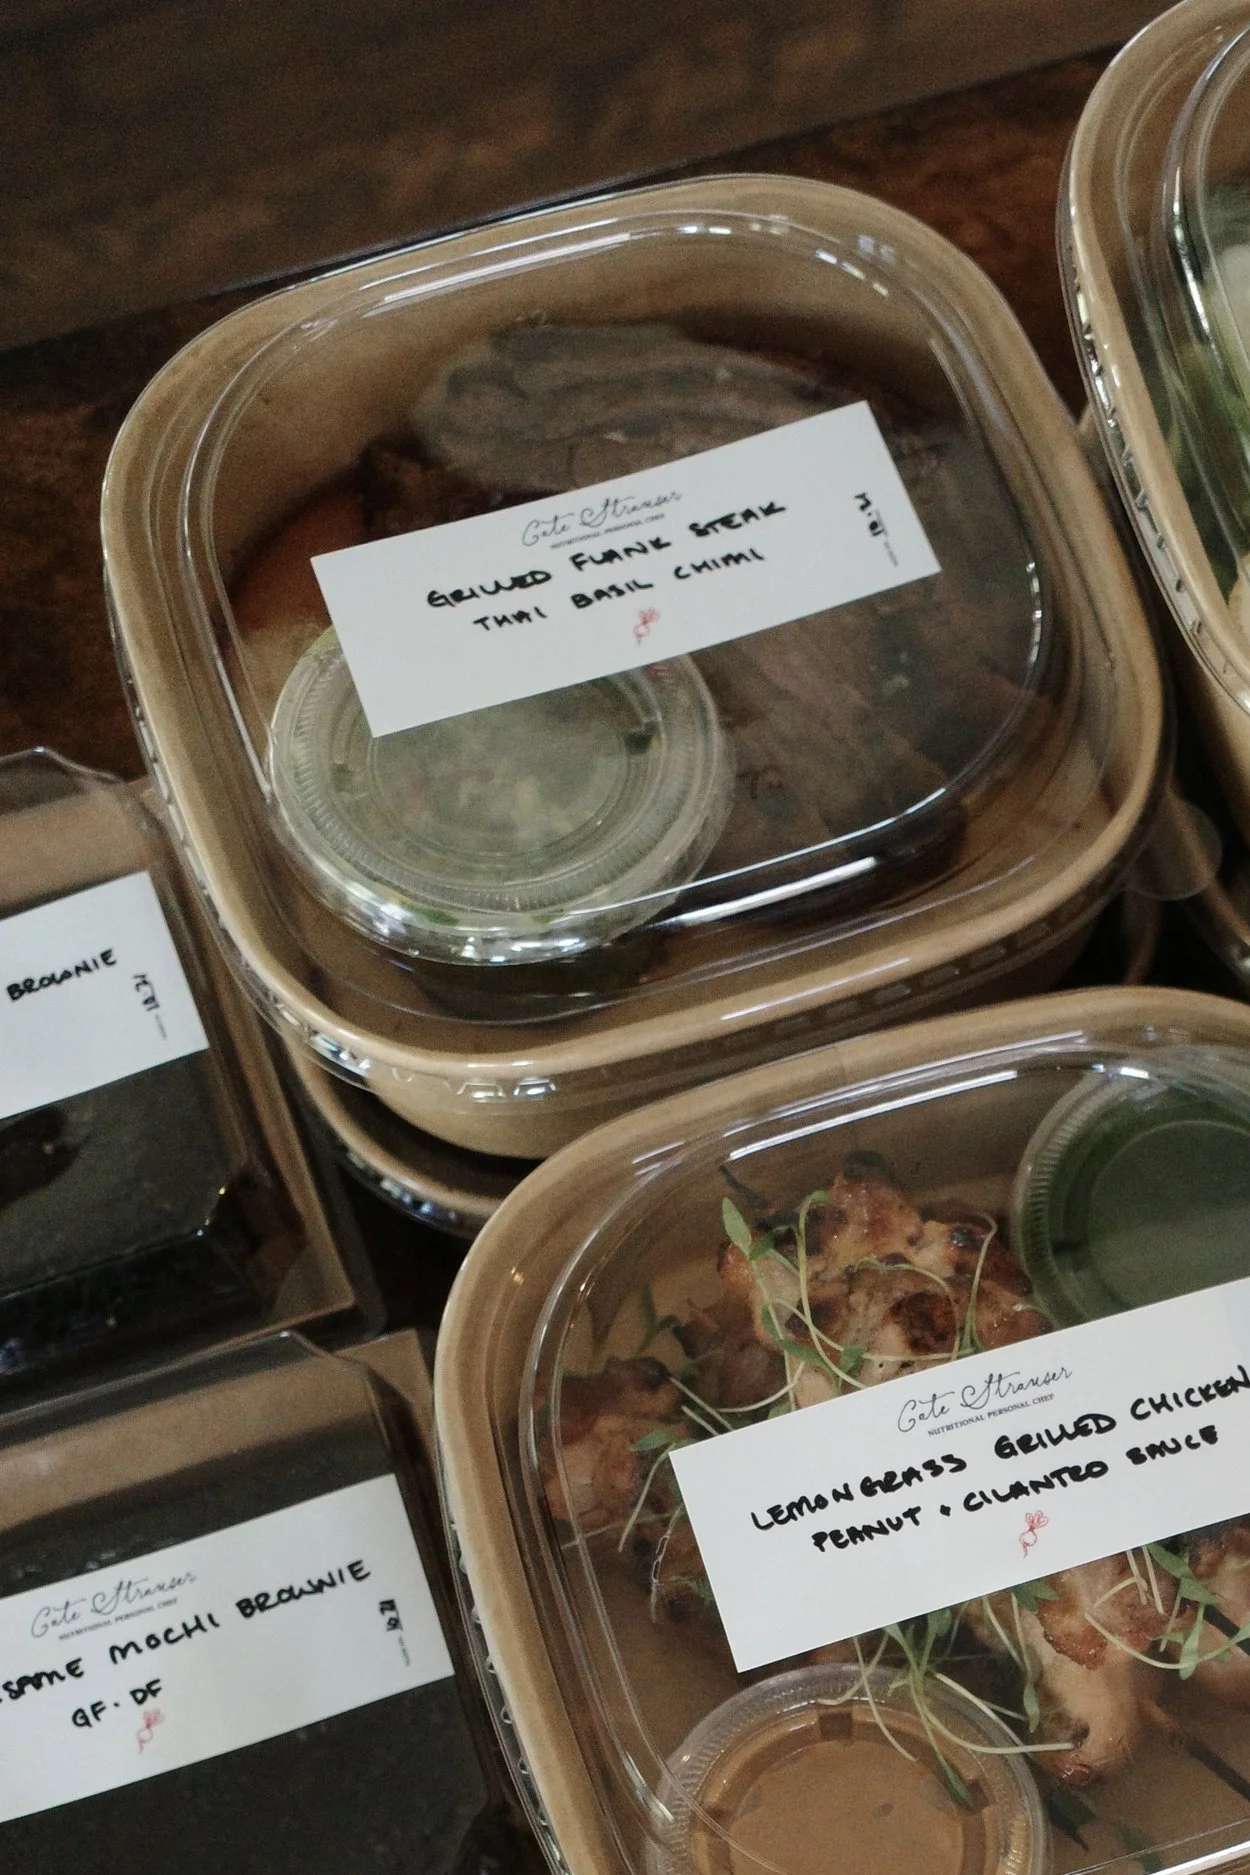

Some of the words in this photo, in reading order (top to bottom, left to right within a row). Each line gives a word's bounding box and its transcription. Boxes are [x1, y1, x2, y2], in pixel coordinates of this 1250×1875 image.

[426, 568, 552, 610] GRILLED
[570, 535, 672, 573] FLANK
[688, 501, 786, 539] STEAK
[473, 605, 547, 632] THAI
[570, 578, 654, 610] BASIL
[674, 548, 766, 581] CHIMI
[6, 948, 117, 1002] BROWNIE
[927, 1413, 986, 1438] NUTRITIONAL
[986, 1402, 1030, 1422] PERSONAL
[1031, 1392, 1056, 1408] CHEF
[994, 1413, 1118, 1461] GRILLED
[811, 1506, 924, 1553] PEANUT
[963, 1460, 1110, 1514] CILANTRO
[1126, 1425, 1219, 1465] SAUCE
[0, 1657, 84, 1704] SAME
[109, 1612, 220, 1664] MOCHI
[235, 1559, 371, 1618] BROWNIE
[129, 1678, 162, 1705] DF
